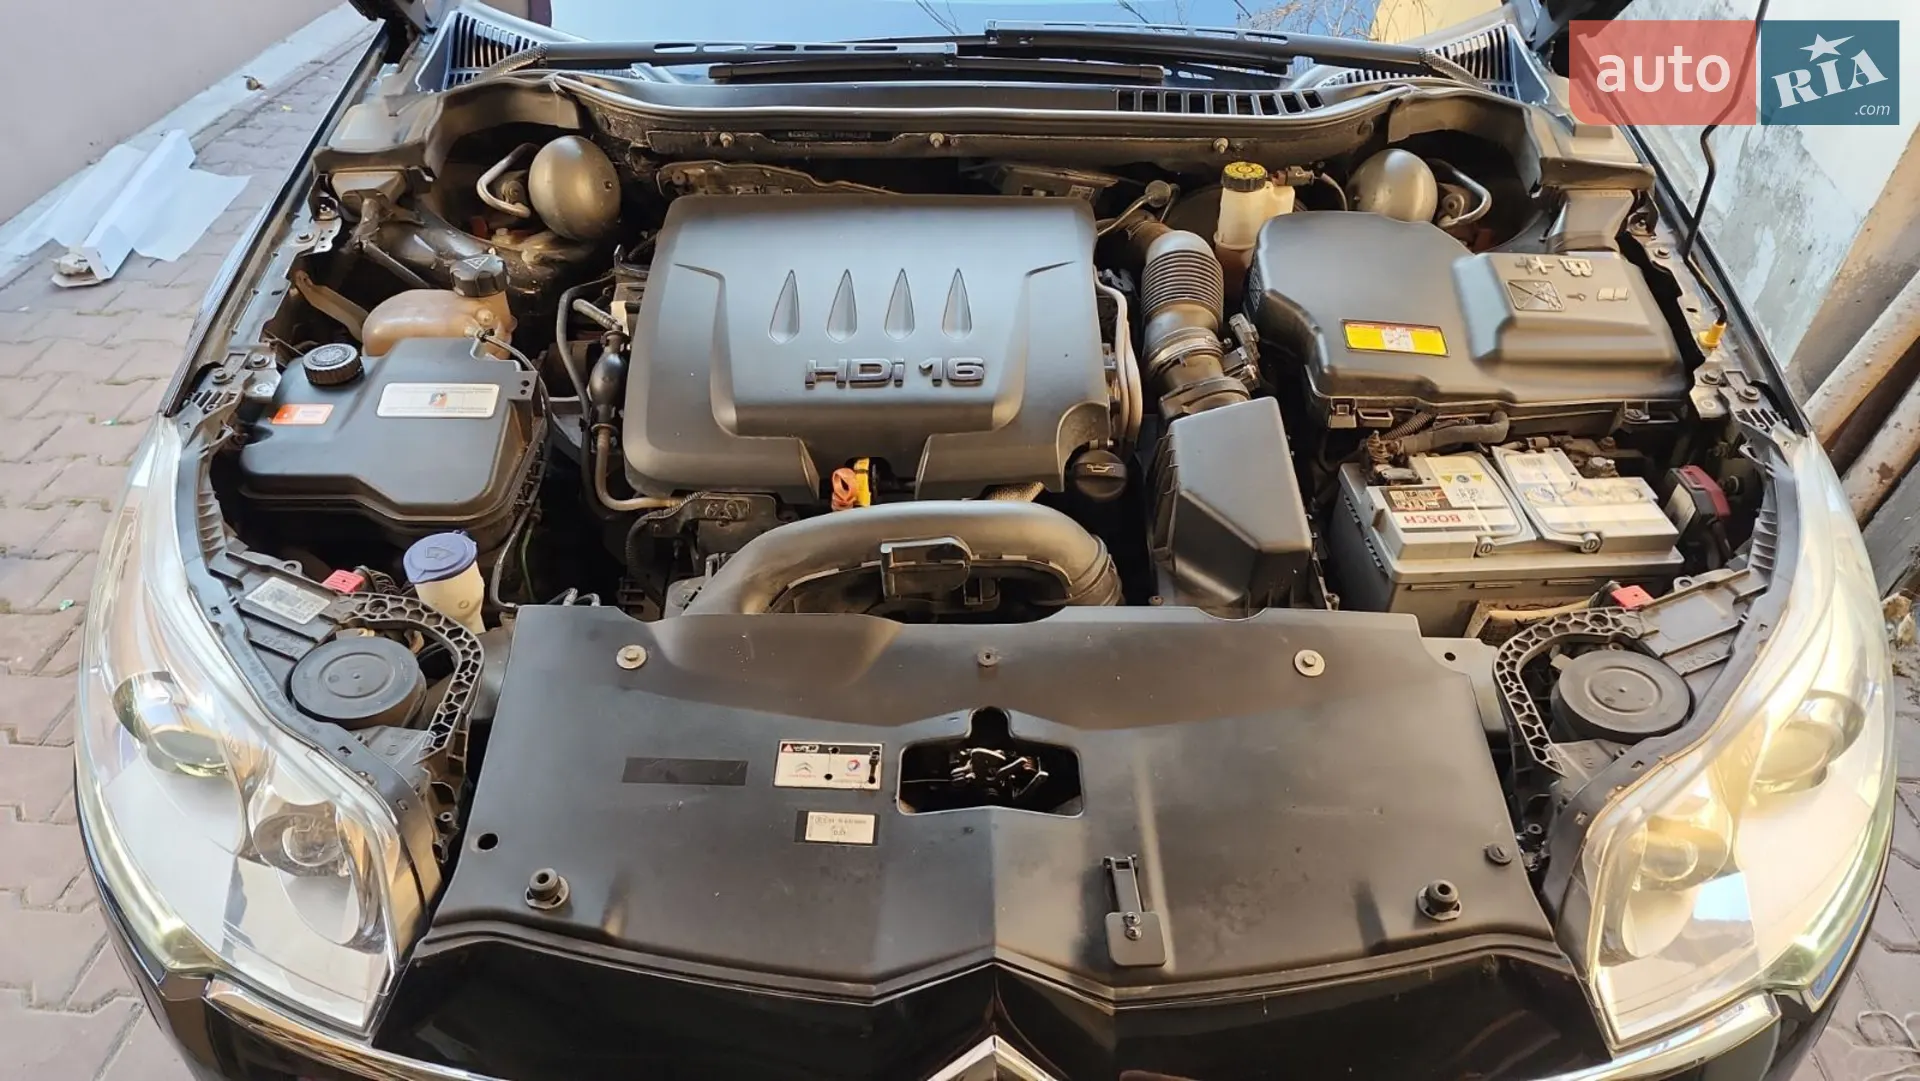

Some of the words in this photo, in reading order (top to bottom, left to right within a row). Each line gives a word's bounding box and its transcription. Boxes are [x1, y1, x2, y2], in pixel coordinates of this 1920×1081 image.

[805, 357, 905, 389] HDi
[918, 357, 985, 388] 16
[1404, 514, 1461, 524] BOSCH
